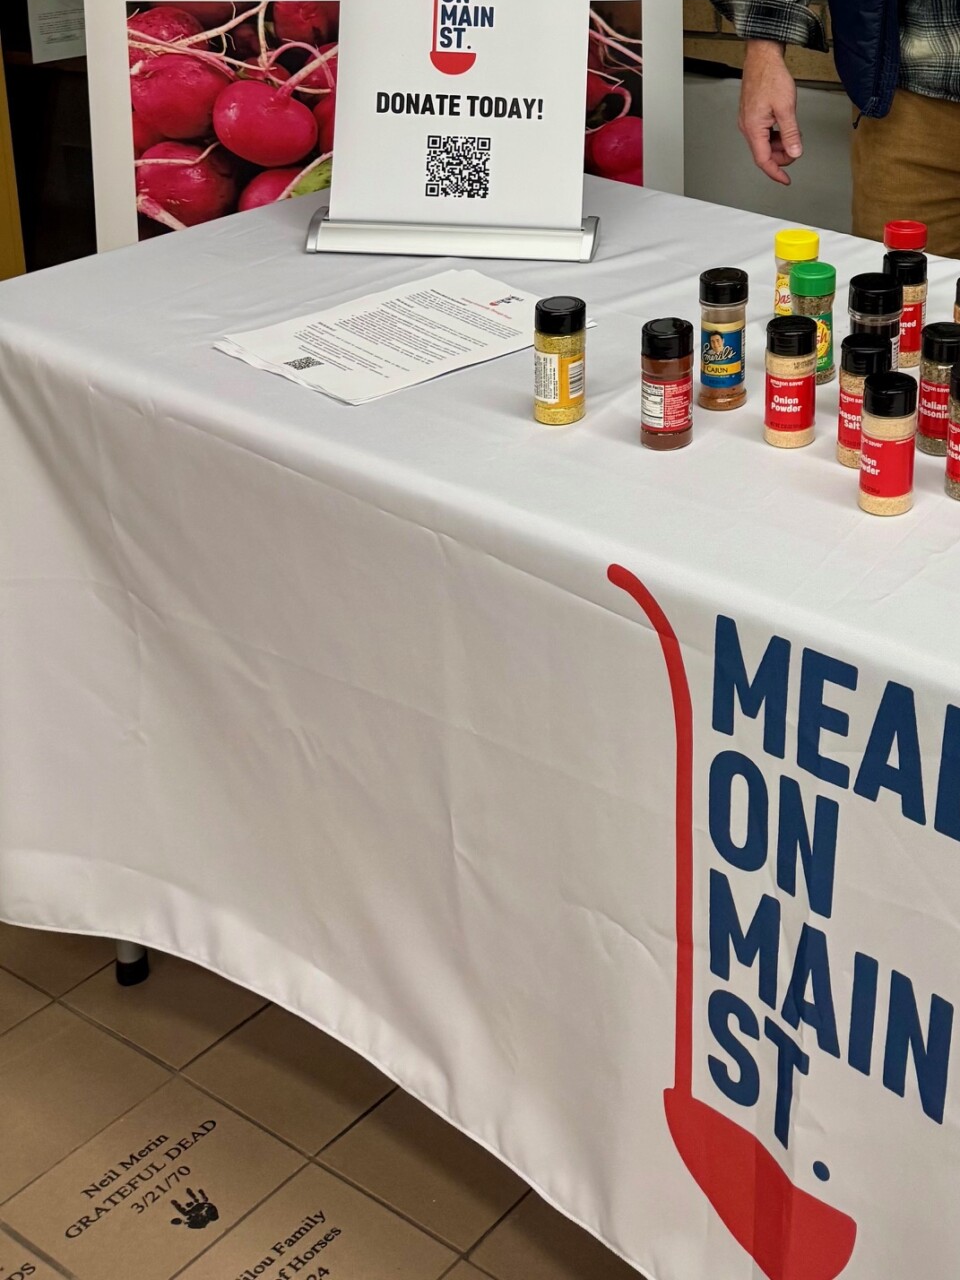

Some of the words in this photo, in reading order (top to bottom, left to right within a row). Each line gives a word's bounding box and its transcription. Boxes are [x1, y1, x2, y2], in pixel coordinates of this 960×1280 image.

[440, 5, 494, 28] MAIN
[439, 26, 471, 49] ST.
[376, 92, 461, 117] DONATE
[467, 95, 544, 120] TODAY!
[771, 402, 803, 413] Powder
[774, 395, 799, 405] Onion
[919, 406, 950, 419] easoni
[922, 398, 948, 410] Italian
[839, 407, 861, 422] eason
[844, 420, 861, 430] Salt
[861, 453, 877, 467] nion
[708, 750, 840, 919] ON
[708, 868, 955, 1125] MAIN
[707, 989, 831, 1182] ST.
[80, 1169, 121, 1199] Neil
[118, 1133, 170, 1170] Merin
[65, 1162, 168, 1239] GRATEFUL
[164, 1119, 217, 1161] DEAD
[130, 1165, 191, 1214] 3/21/70
[271, 1210, 326, 1256] Family
[286, 1227, 342, 1273] Horses
